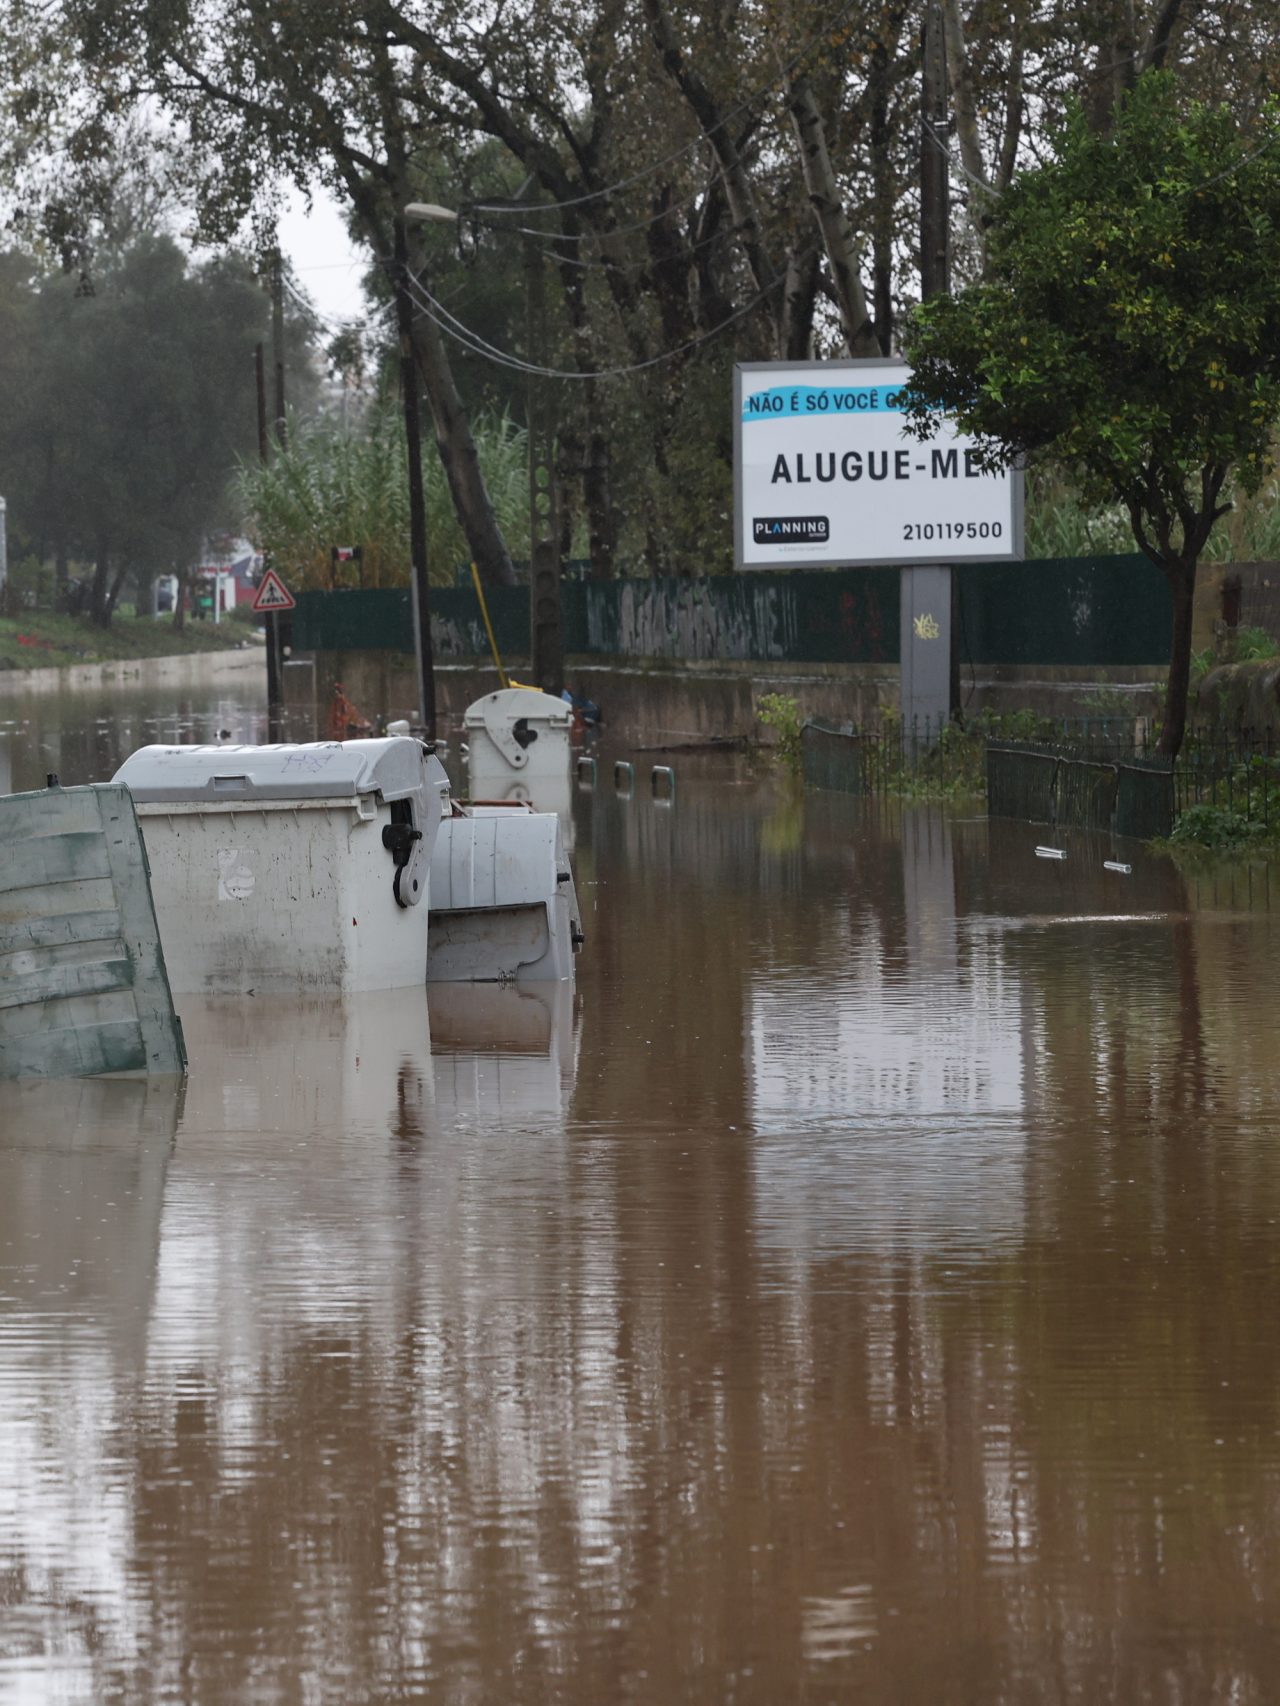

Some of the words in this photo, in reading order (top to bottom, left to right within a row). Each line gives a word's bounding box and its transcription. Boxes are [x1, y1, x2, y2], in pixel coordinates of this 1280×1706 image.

[749, 392, 784, 412] NÃO
[790, 391, 800, 412] É
[805, 390, 829, 411] SÓ
[833, 389, 879, 410] VOCÊ
[770, 448, 981, 484] ALUGUE-ME
[755, 520, 826, 535] PLANNING
[903, 521, 1002, 541] 210119500
